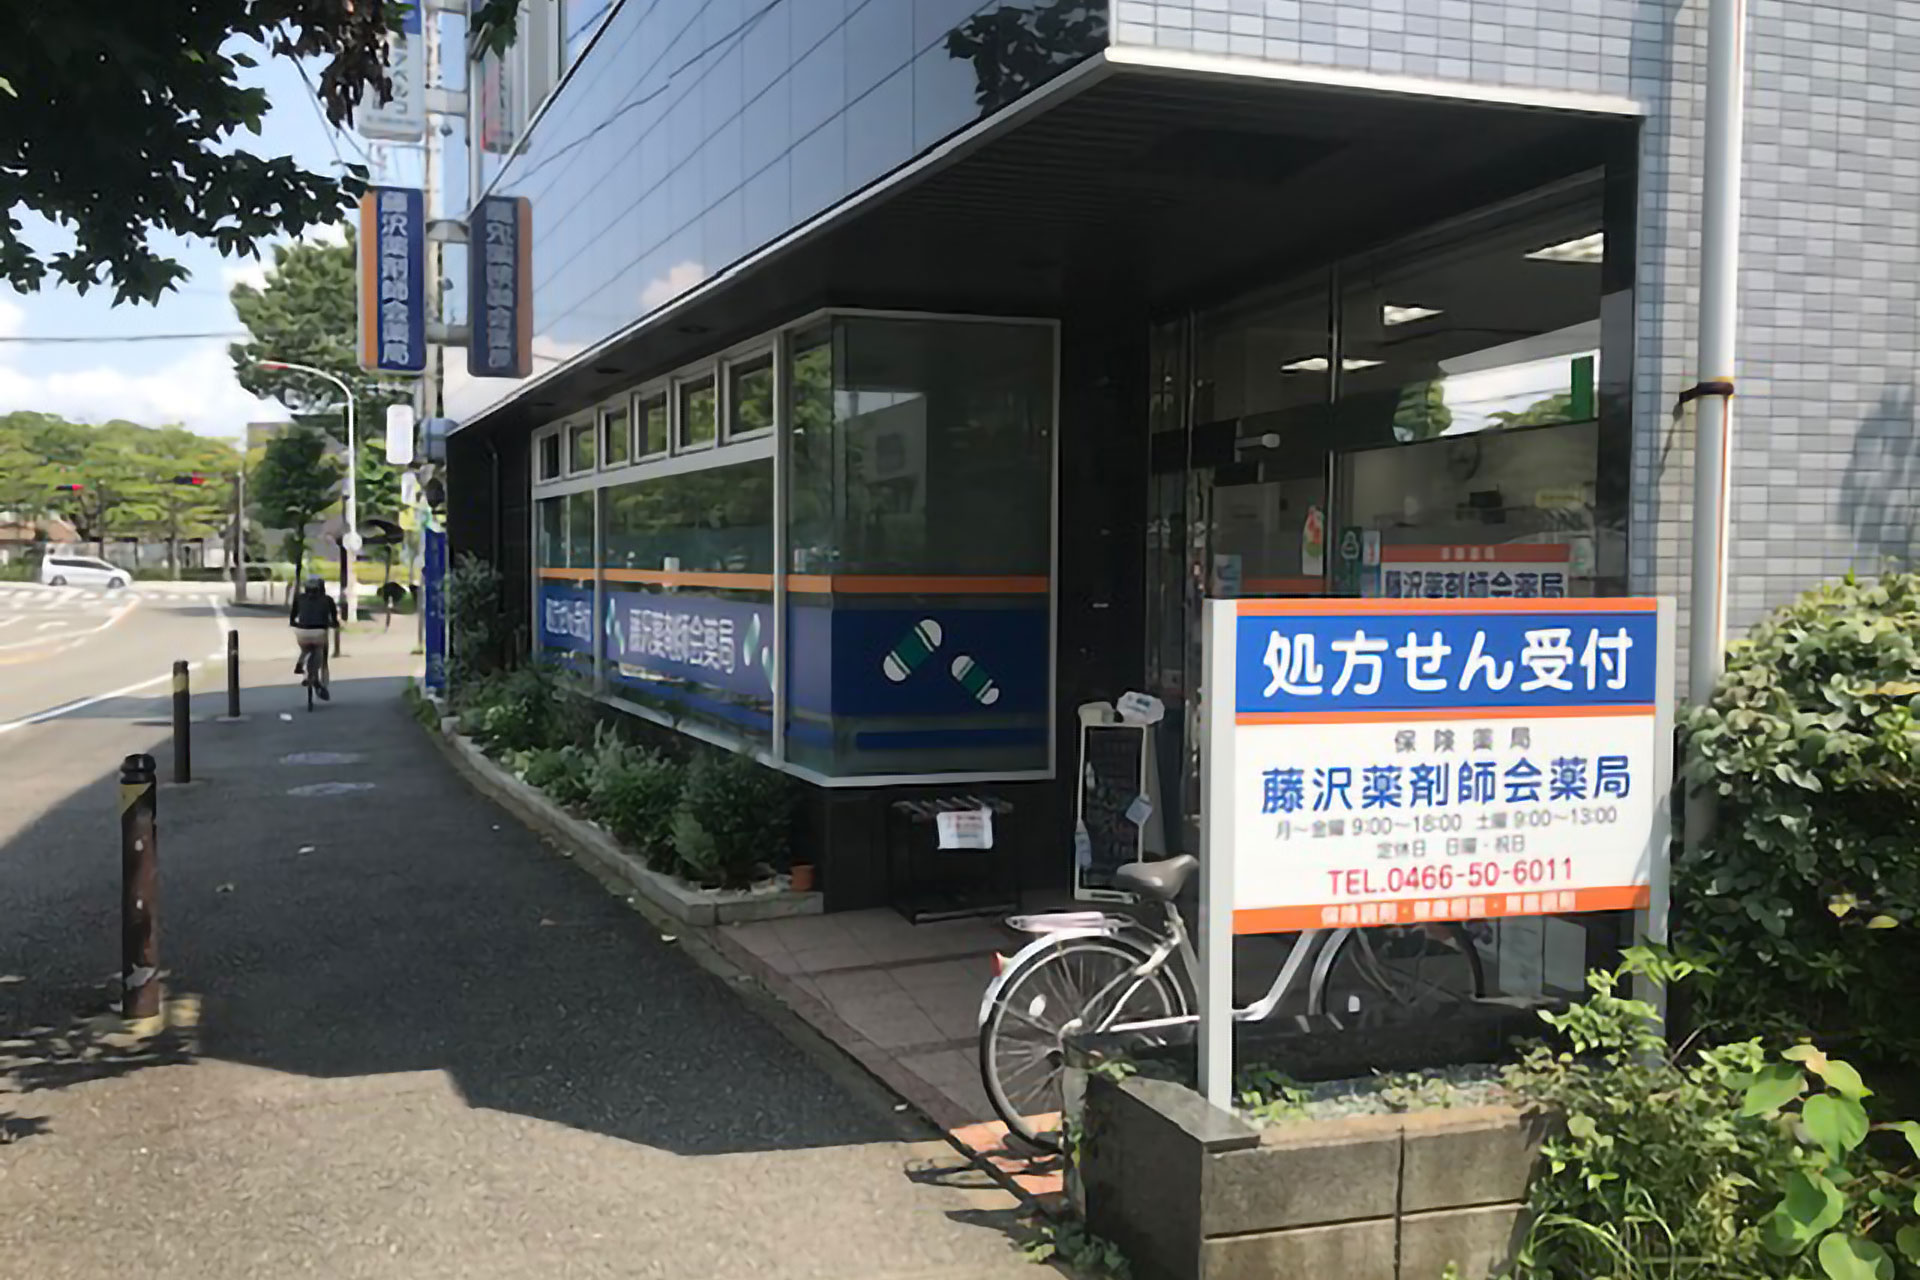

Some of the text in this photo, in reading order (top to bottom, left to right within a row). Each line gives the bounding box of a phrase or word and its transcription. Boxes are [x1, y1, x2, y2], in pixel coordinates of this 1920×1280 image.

[1262, 627, 1633, 698] 処方せん受付
[1394, 726, 1532, 753] 保険薬局
[1261, 755, 1631, 814] 藤沢薬剤師会薬局
[1327, 856, 1573, 897] TEL.0466-50-6011
